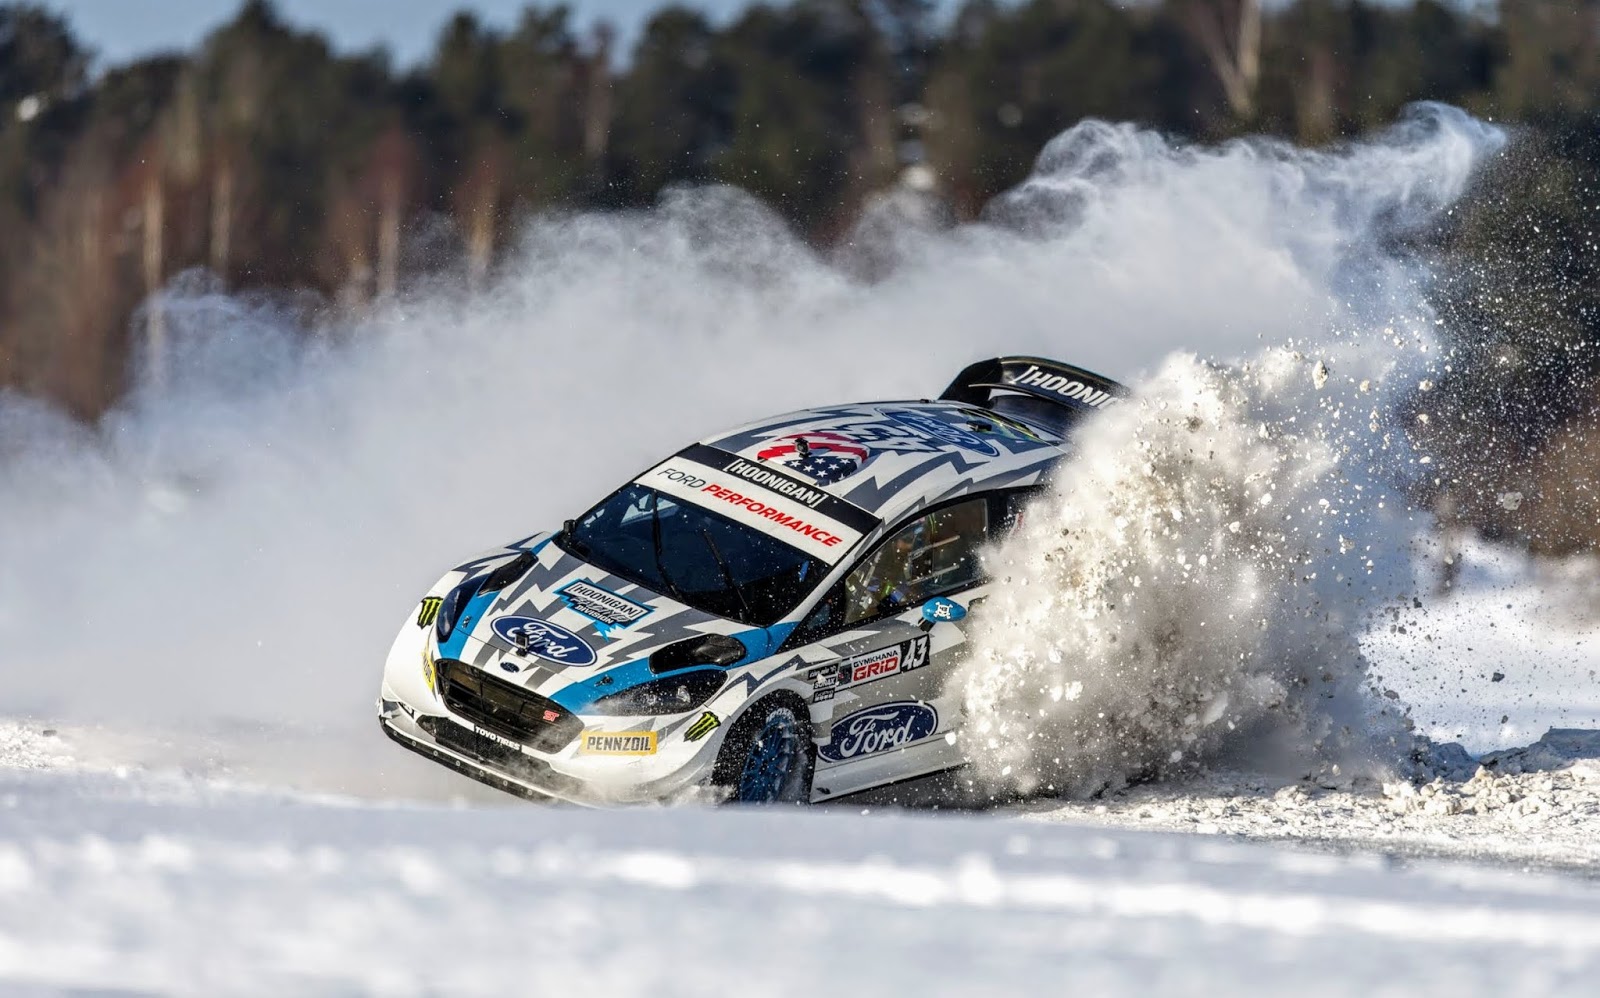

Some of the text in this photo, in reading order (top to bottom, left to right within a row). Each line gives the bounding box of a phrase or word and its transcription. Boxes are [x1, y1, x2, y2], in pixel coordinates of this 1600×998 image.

[657, 467, 844, 547] FORD PERFORMANCE
[575, 604, 615, 624] DIVISION
[506, 622, 579, 658] Ford
[901, 635, 929, 670] 43
[853, 649, 899, 668] GYMKHANA
[543, 710, 560, 722] ST
[475, 726, 521, 751] TOYO TIRES
[586, 735, 652, 752] PENNZOIL
[839, 710, 916, 758] Ford
